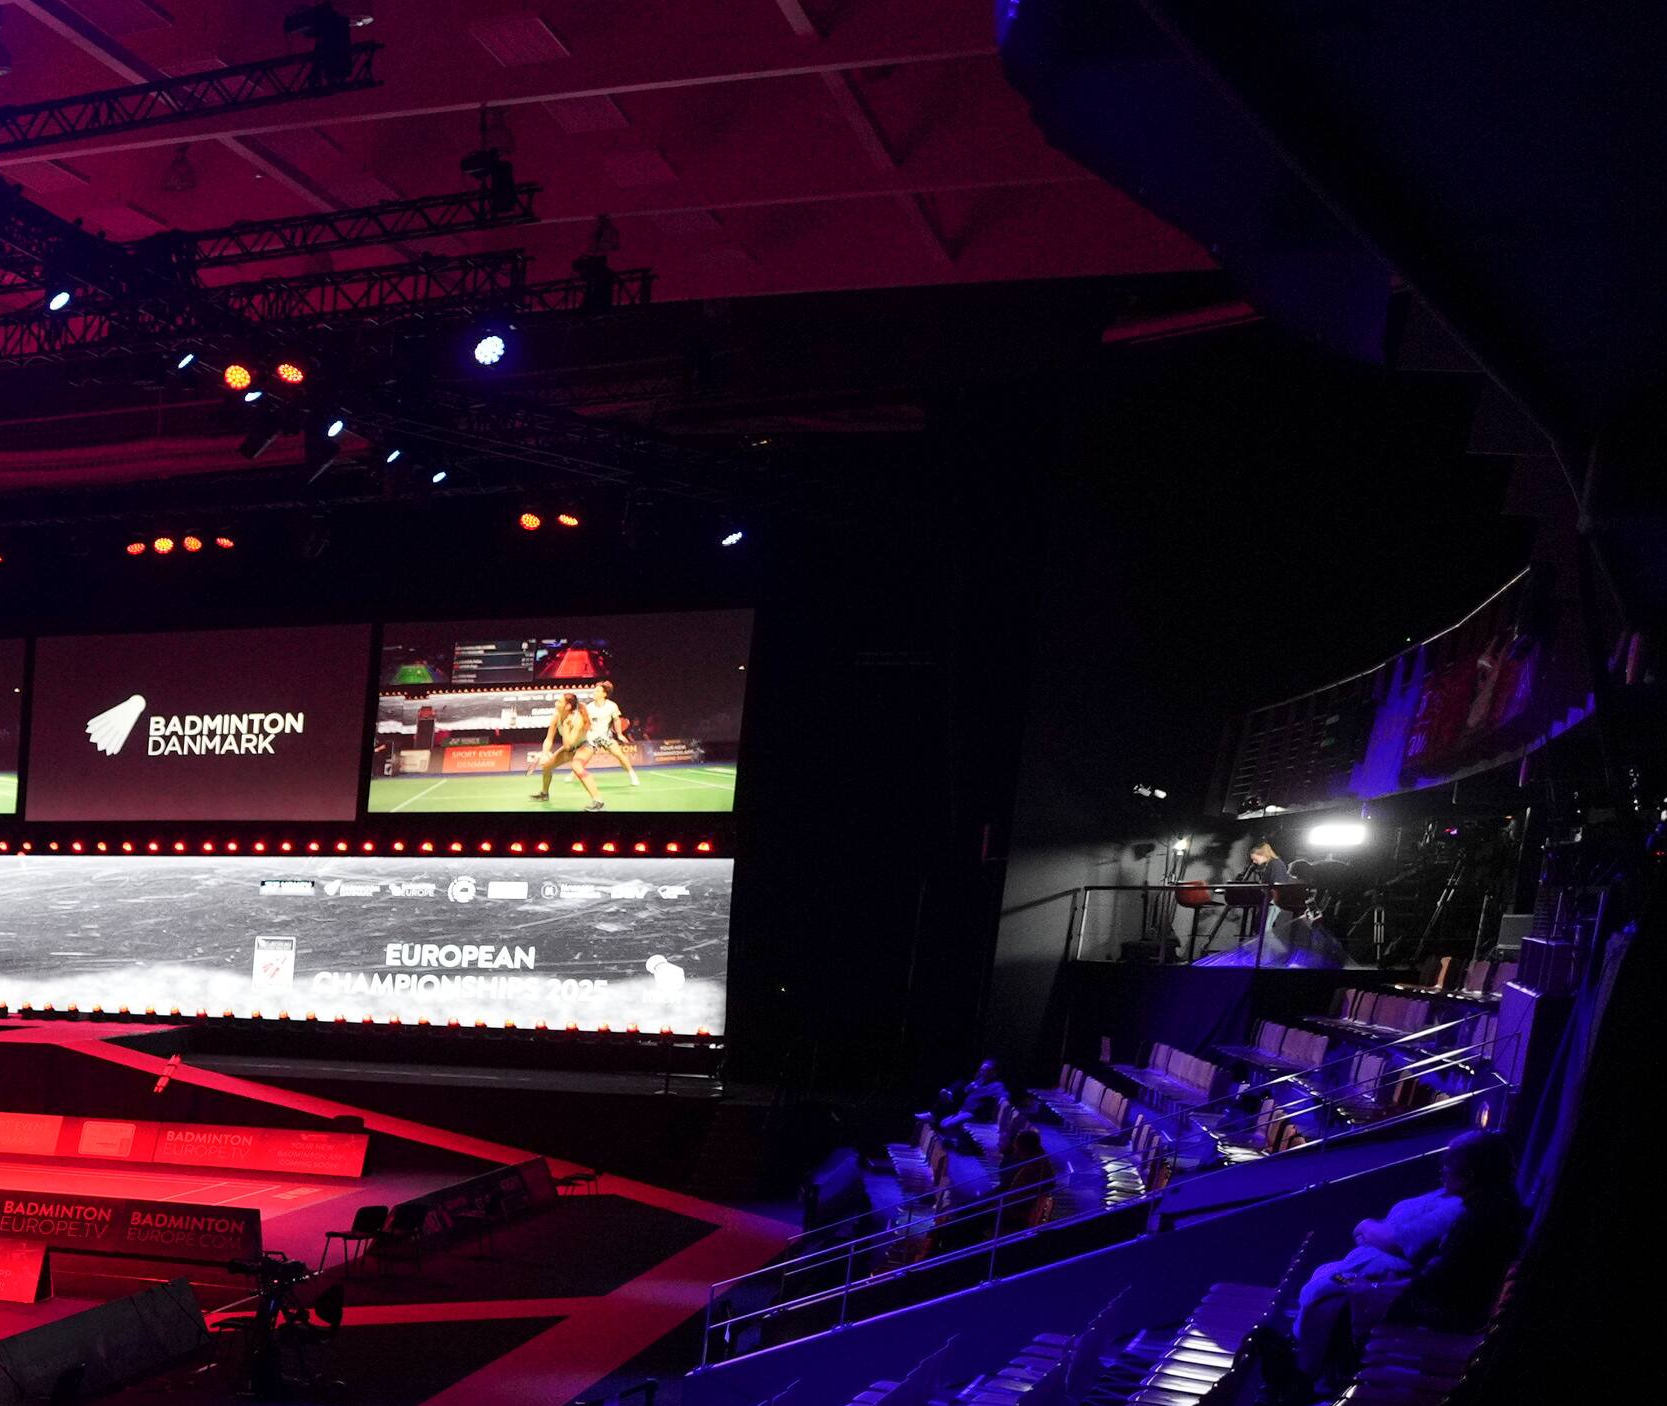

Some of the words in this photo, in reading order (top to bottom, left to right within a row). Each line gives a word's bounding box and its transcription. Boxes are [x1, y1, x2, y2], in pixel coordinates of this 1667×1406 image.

[149, 712, 305, 736] BADMINTON
[147, 733, 276, 756] DANMARK
[384, 943, 537, 969] EUROPEAN
[312, 972, 541, 1001] CHAMPIONSHIPS
[546, 978, 610, 1001] 2025
[166, 1130, 253, 1147] BADMINTON
[3, 1200, 113, 1222] BADMINTON
[129, 1211, 245, 1235] BADMINTON
